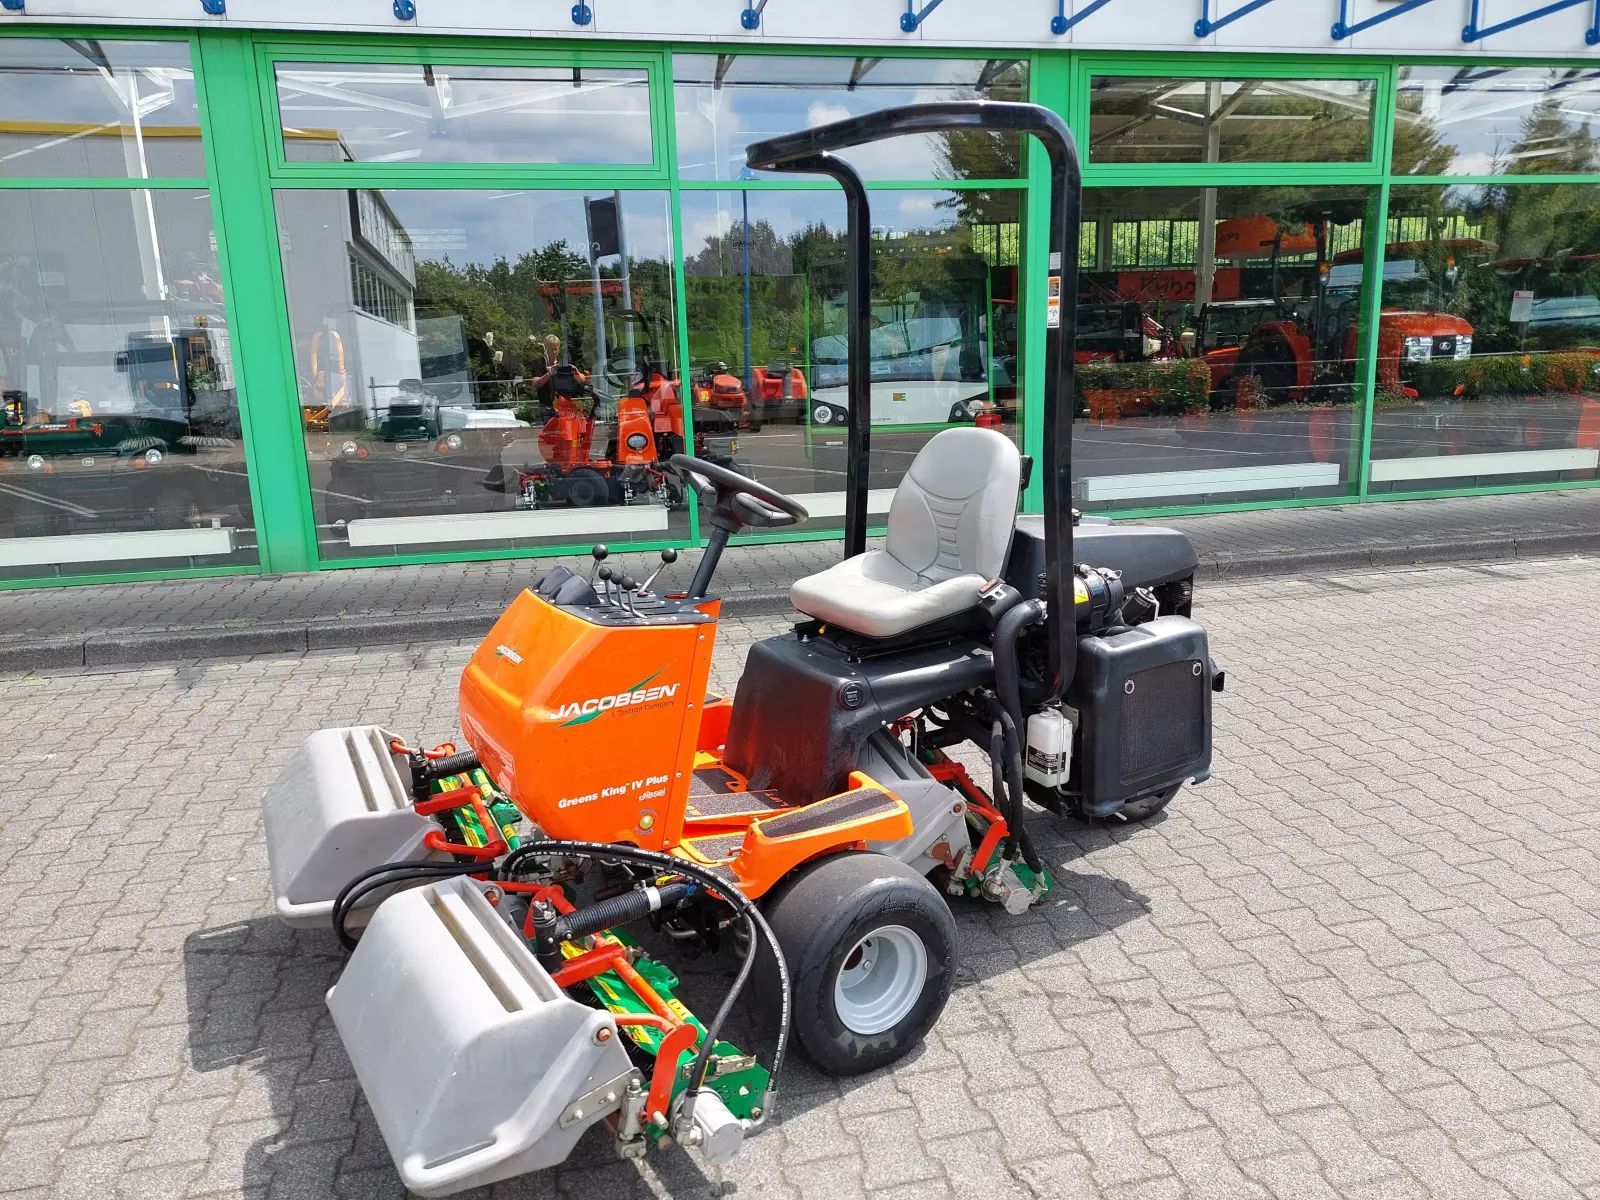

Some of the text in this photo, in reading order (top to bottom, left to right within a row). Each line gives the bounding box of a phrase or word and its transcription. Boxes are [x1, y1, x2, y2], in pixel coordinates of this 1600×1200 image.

[550, 683, 679, 720] JACOBSEN
[618, 706, 643, 717] Textron
[644, 700, 675, 712] Company
[558, 792, 599, 808] Greens
[631, 779, 644, 790] IV
[645, 774, 669, 787] Plus
[638, 787, 666, 801] diesel
